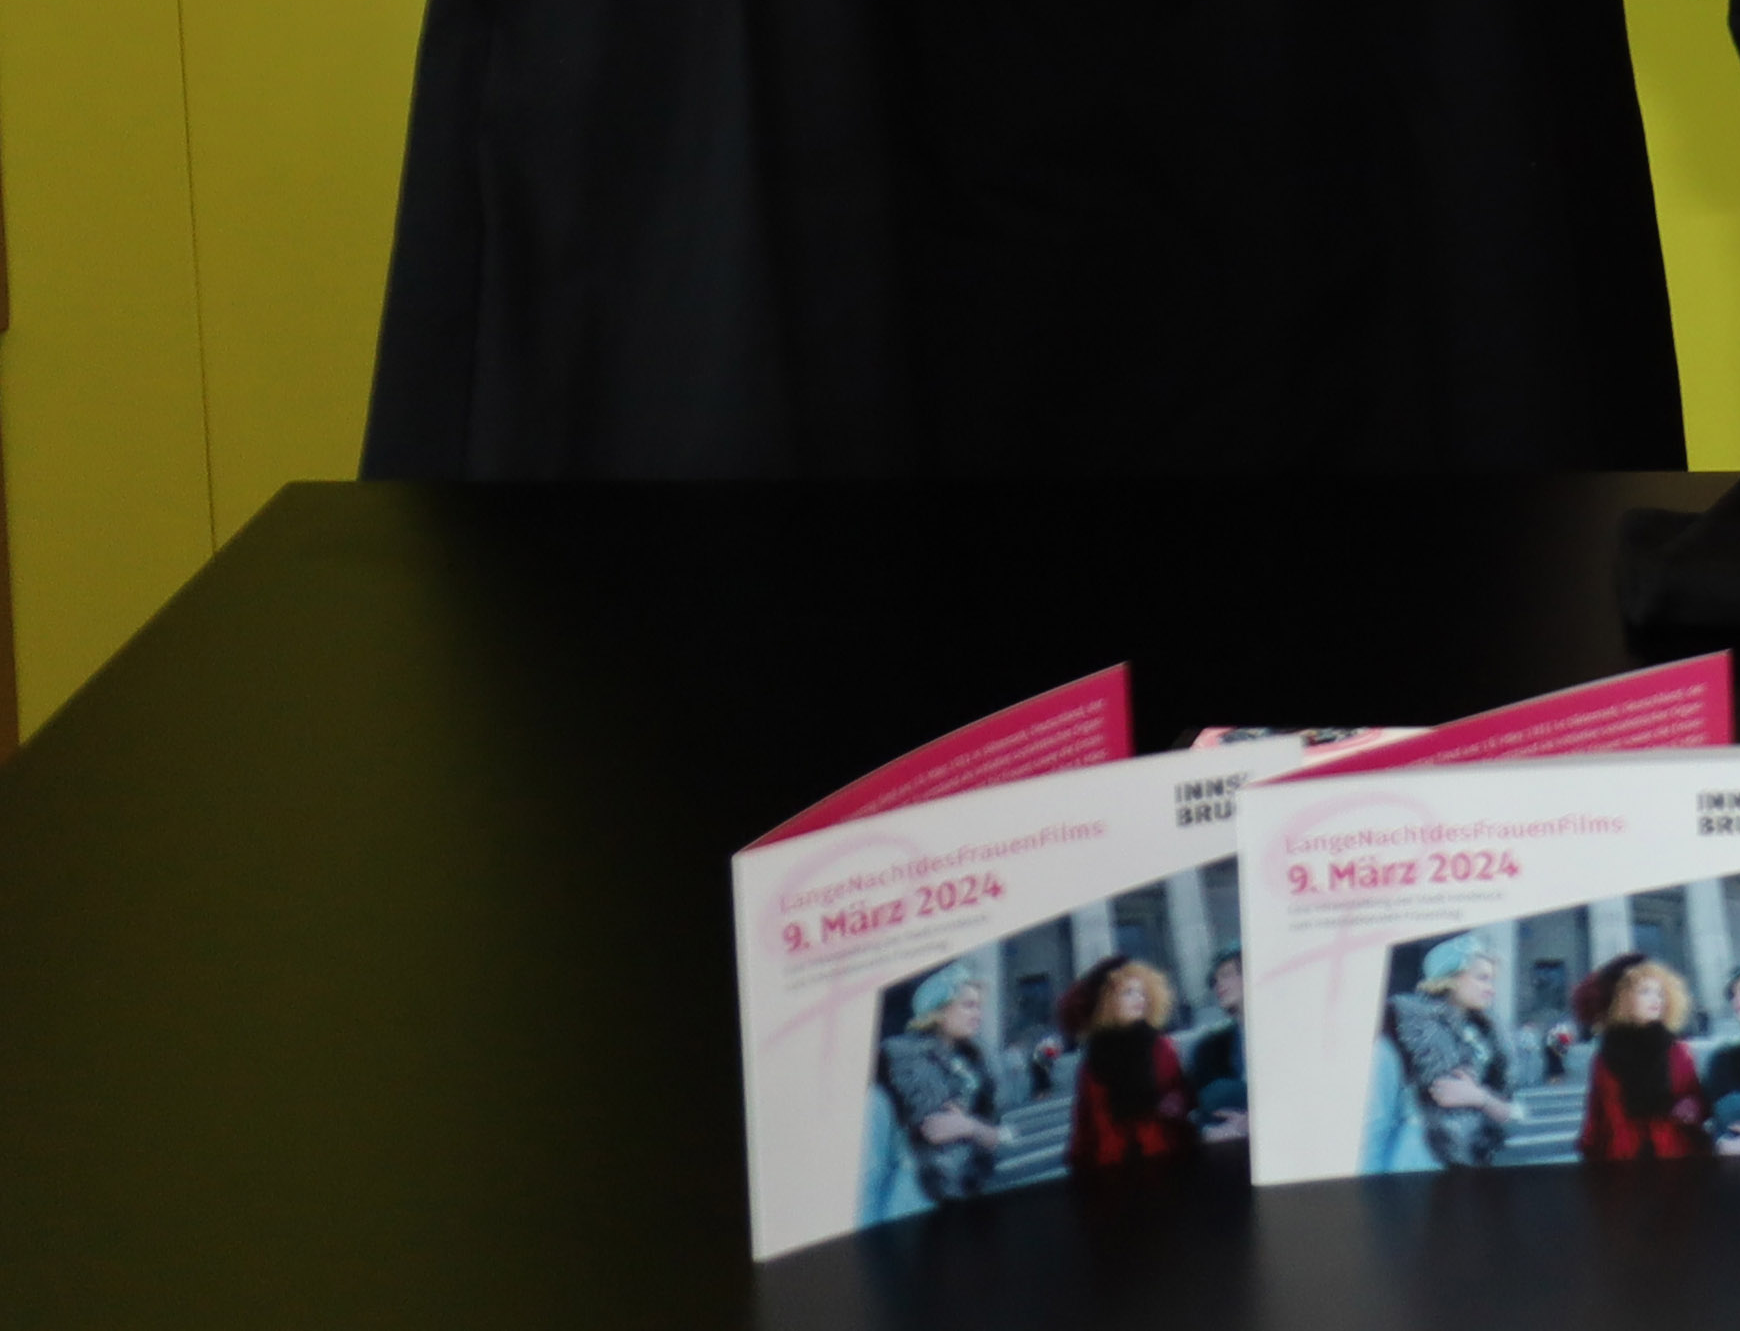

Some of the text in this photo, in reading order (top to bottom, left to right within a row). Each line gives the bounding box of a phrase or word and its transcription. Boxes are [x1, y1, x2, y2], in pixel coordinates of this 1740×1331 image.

[1286, 850, 1520, 895] 9. März 2024
[782, 922, 813, 953] 9.
[819, 896, 907, 947] März
[917, 873, 1007, 918] 2024
